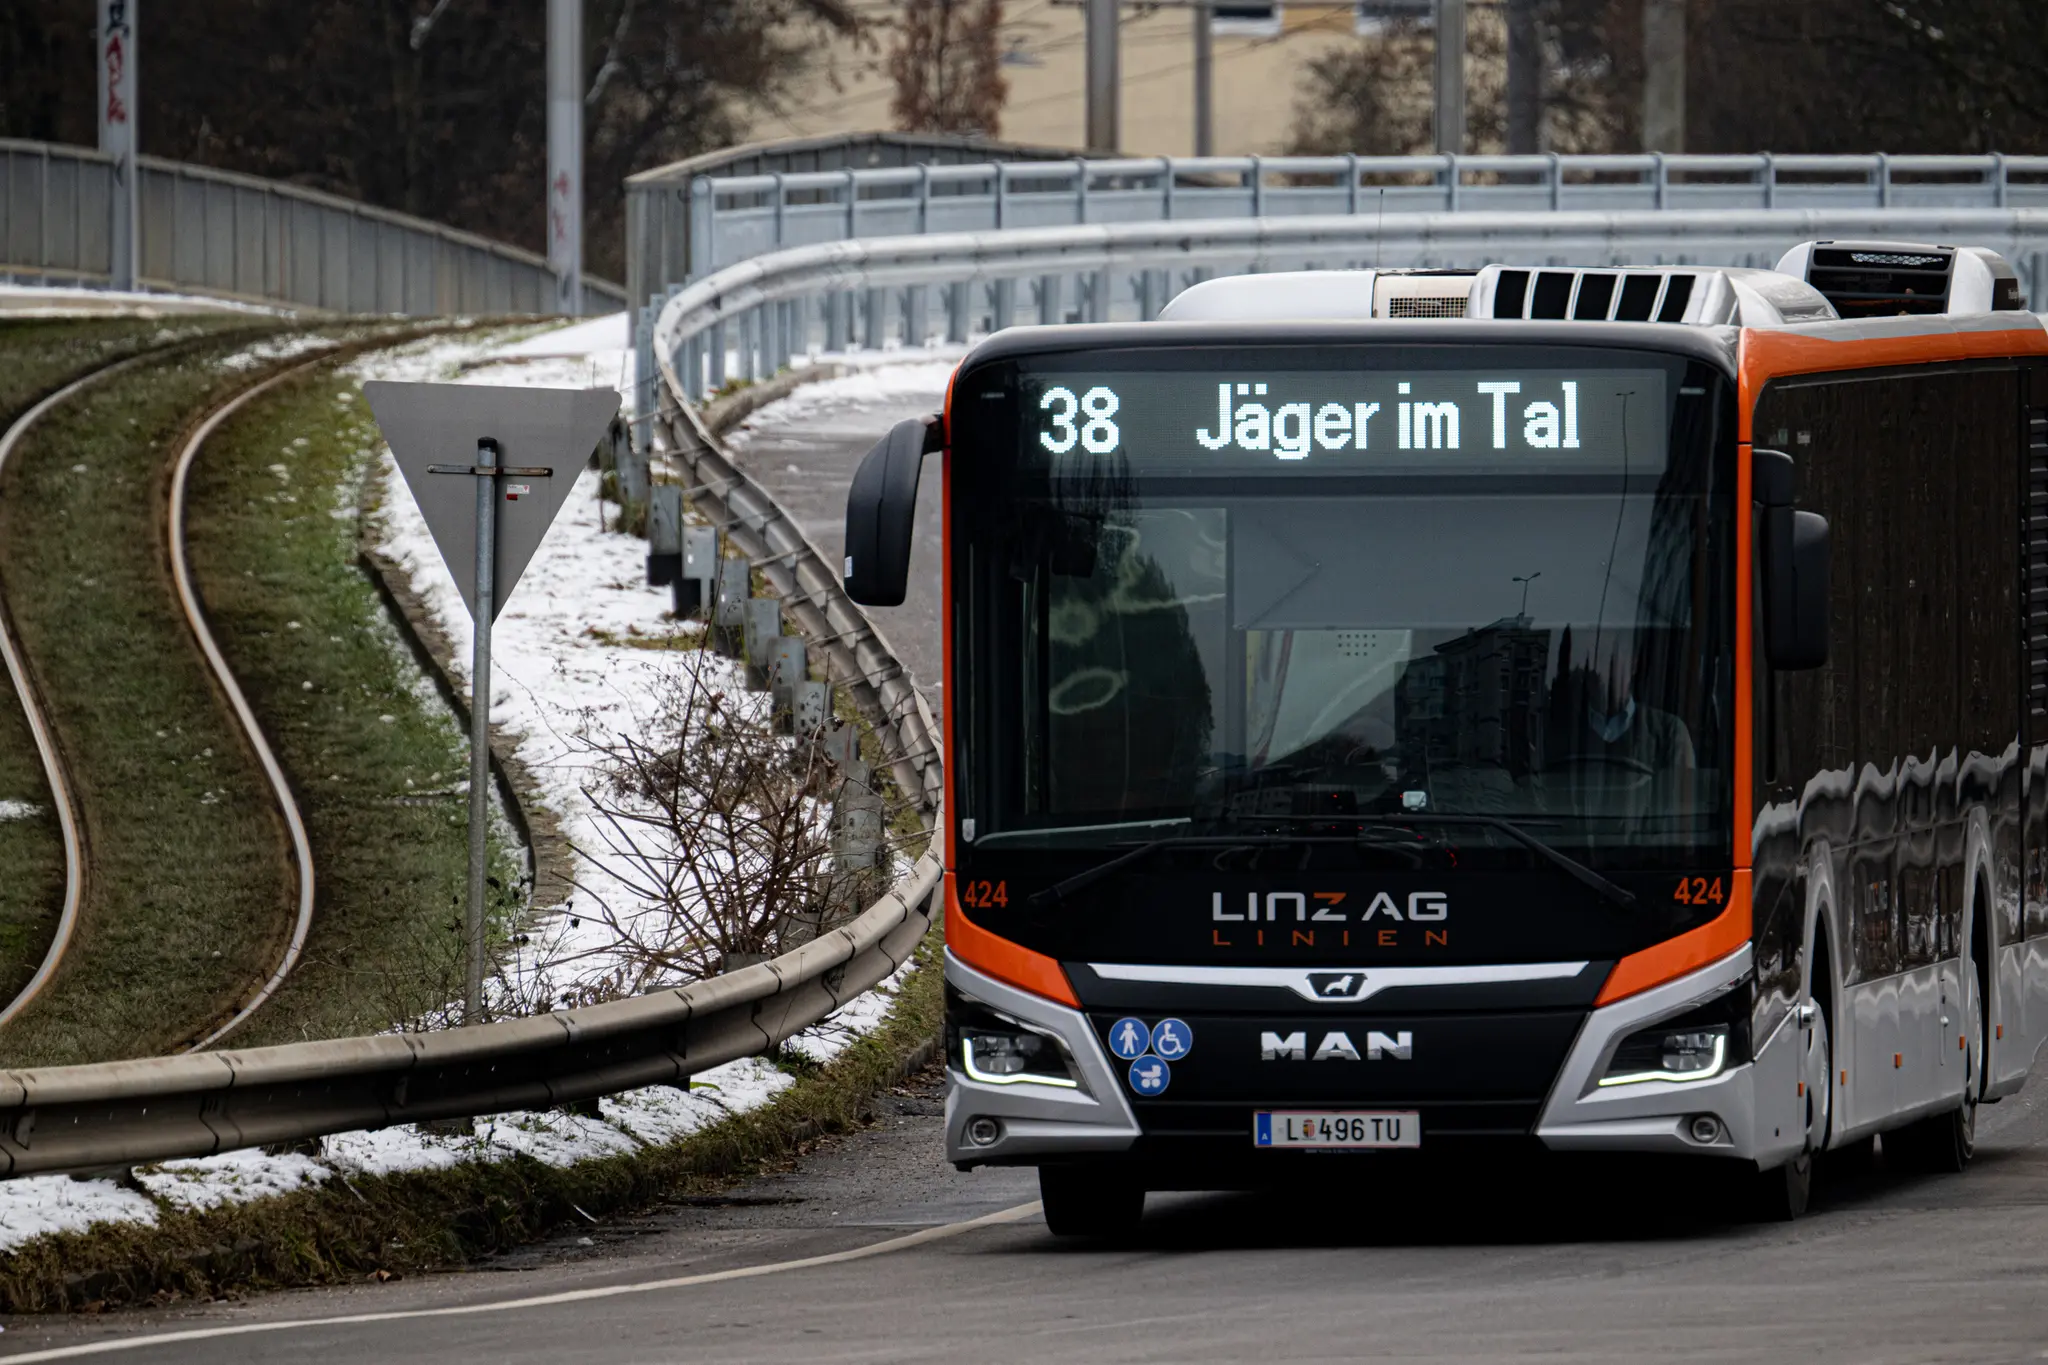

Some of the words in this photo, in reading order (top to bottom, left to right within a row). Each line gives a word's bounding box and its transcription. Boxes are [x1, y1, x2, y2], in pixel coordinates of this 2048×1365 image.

[1040, 386, 1119, 453] 38
[1196, 383, 1380, 460] Jäger
[1398, 382, 1460, 450] im
[1477, 381, 1581, 450] Tal
[964, 880, 1009, 908] 424
[1673, 876, 1723, 905] 424
[1212, 892, 1347, 921] LINZ
[1361, 892, 1448, 921] AG
[1212, 930, 1448, 946] LINIEN
[1261, 1031, 1413, 1060] MAN
[1261, 1132, 1269, 1141] A
[1287, 1118, 1299, 1141] L
[1319, 1118, 1365, 1141] 496
[1370, 1118, 1400, 1141] TU
